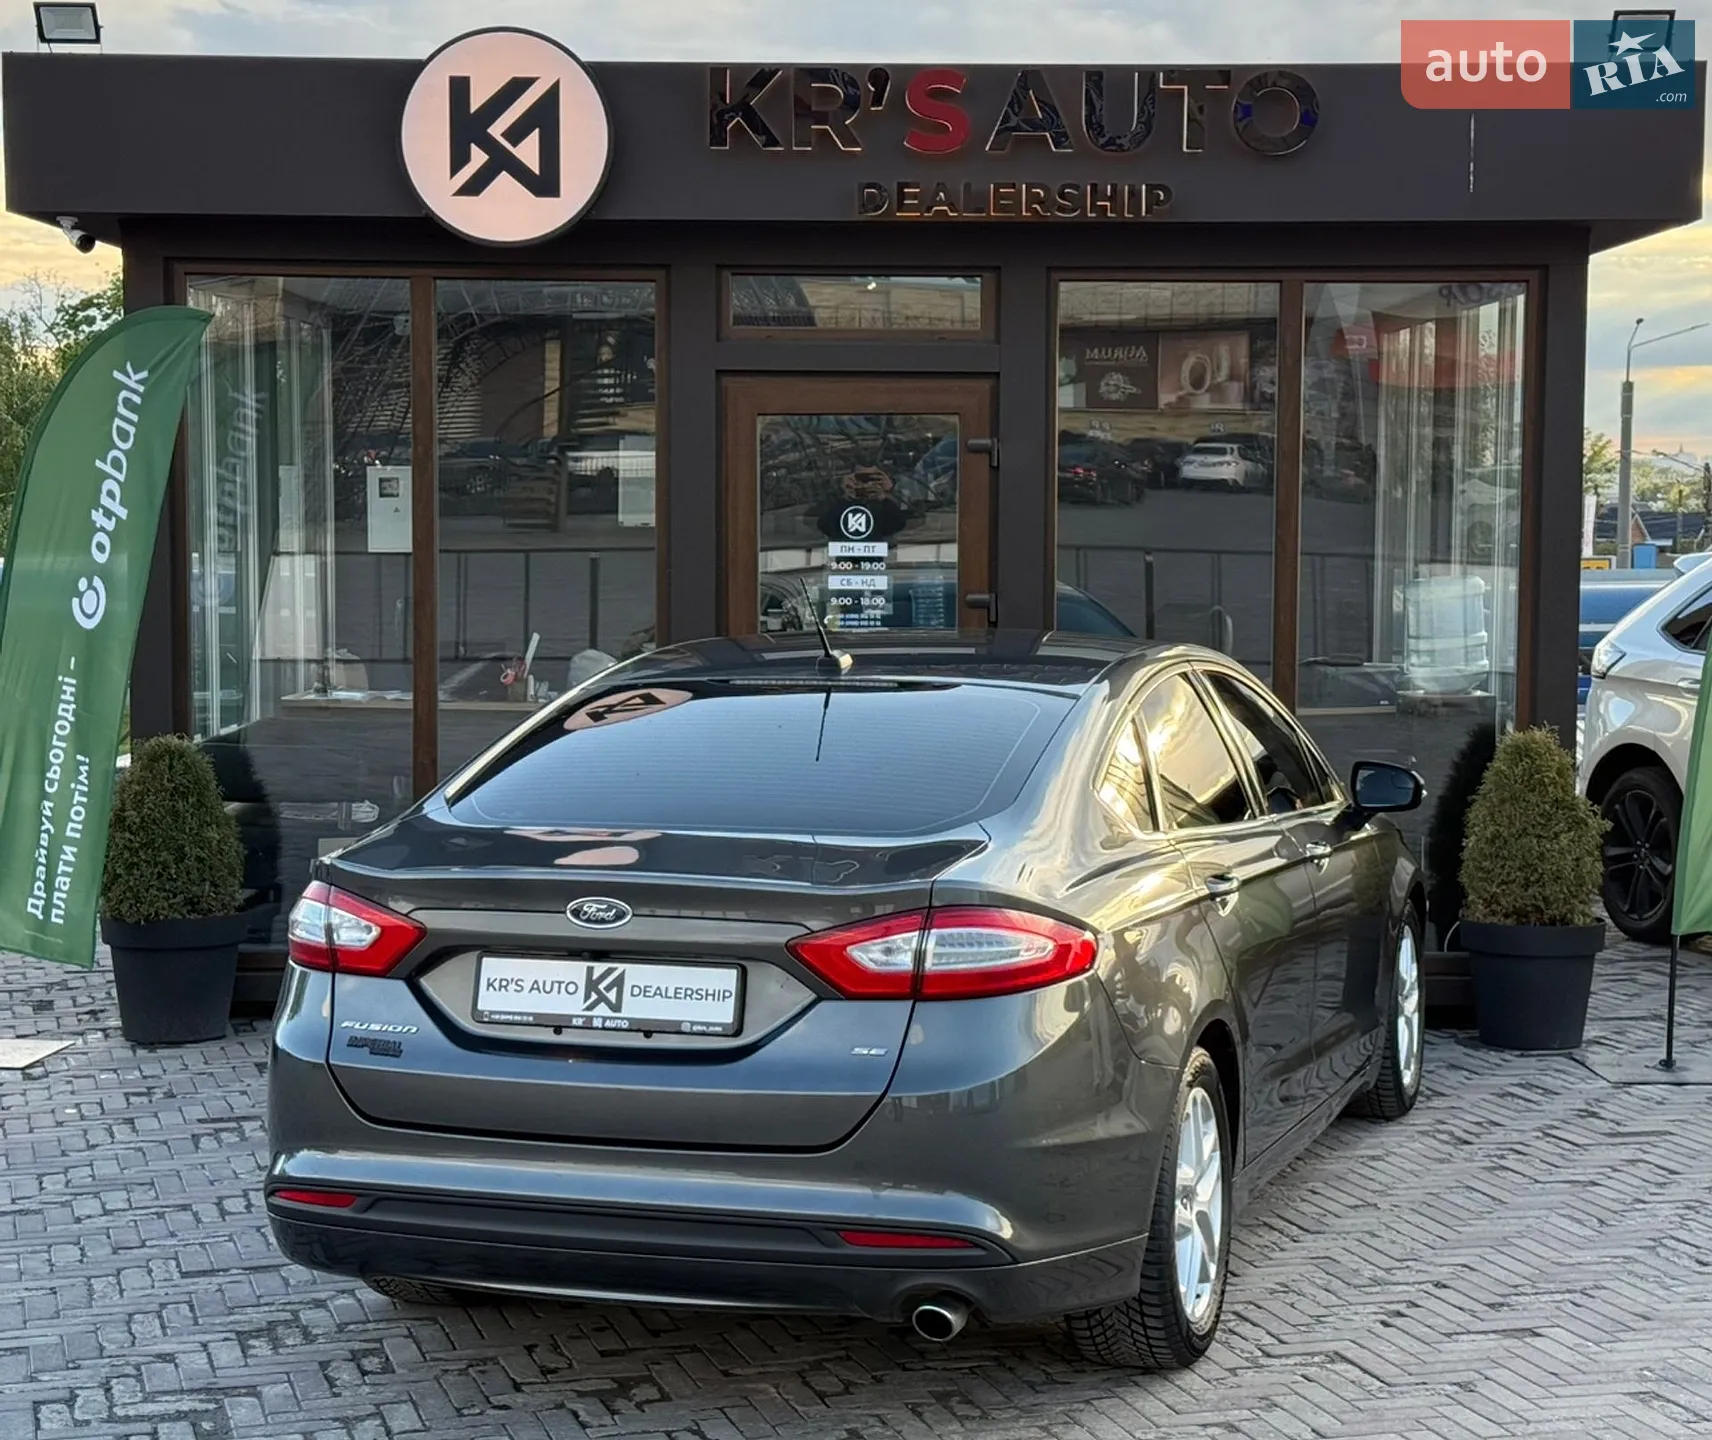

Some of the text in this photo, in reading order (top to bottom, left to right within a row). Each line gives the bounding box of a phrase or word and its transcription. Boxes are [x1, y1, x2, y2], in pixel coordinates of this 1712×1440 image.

[708, 66, 1321, 157] KR'S AUTO
[857, 182, 1173, 217] DEALERSHIP
[91, 361, 149, 564] otpbank
[26, 800, 55, 920] Драйвуй
[45, 675, 77, 794] сьогодні
[50, 754, 90, 925] плати потім!
[579, 903, 616, 922] Ford
[485, 977, 525, 993] KR'S
[528, 979, 579, 995] AUTO
[630, 984, 733, 1002] DEALERSHIP
[341, 1020, 419, 1034] FUSION
[604, 1019, 629, 1028] AUTO
